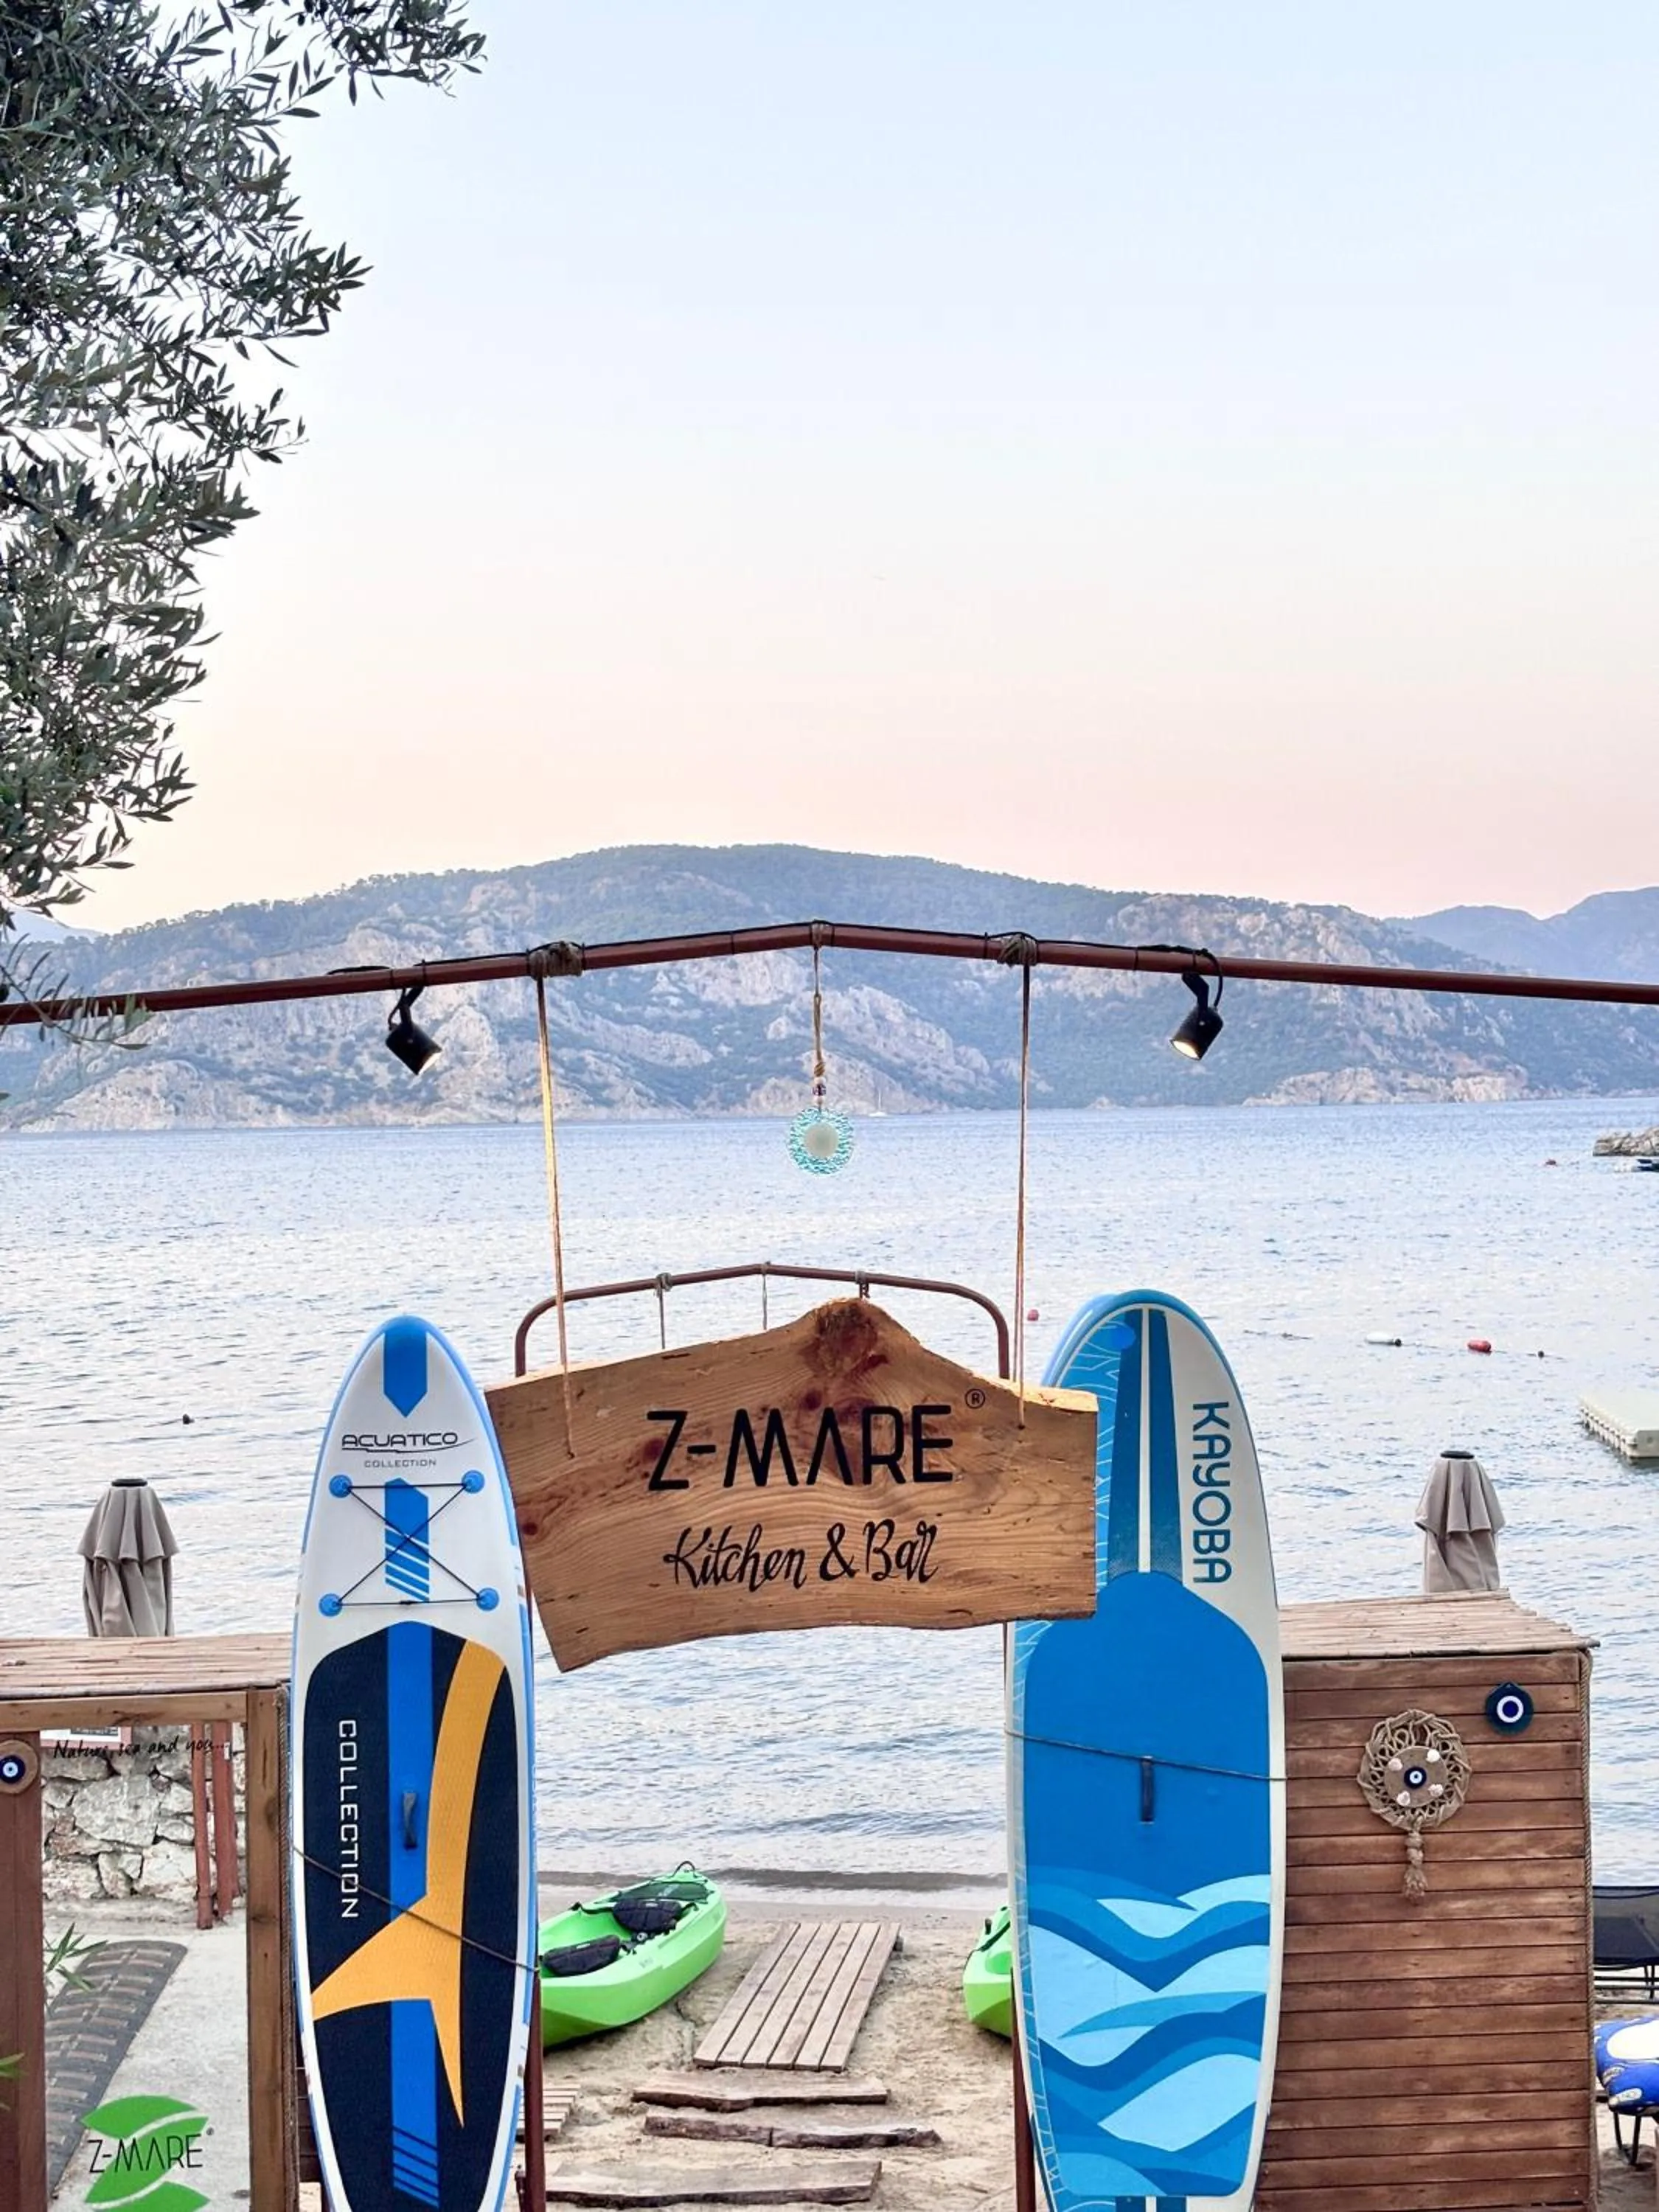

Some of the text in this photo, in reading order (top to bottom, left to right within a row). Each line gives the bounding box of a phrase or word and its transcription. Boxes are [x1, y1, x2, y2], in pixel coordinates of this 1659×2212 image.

[341, 1432, 459, 1447] ACUATICO
[364, 1458, 437, 1468] COLLECTION
[646, 1405, 953, 1491] Z-MARE
[1192, 1401, 1232, 1584] KAYOBA
[663, 1518, 939, 1593] Kitchen & Bar
[148, 1735, 180, 1753] and
[338, 1719, 359, 1918] COLLECTION
[87, 2133, 204, 2174] Z-MARE
